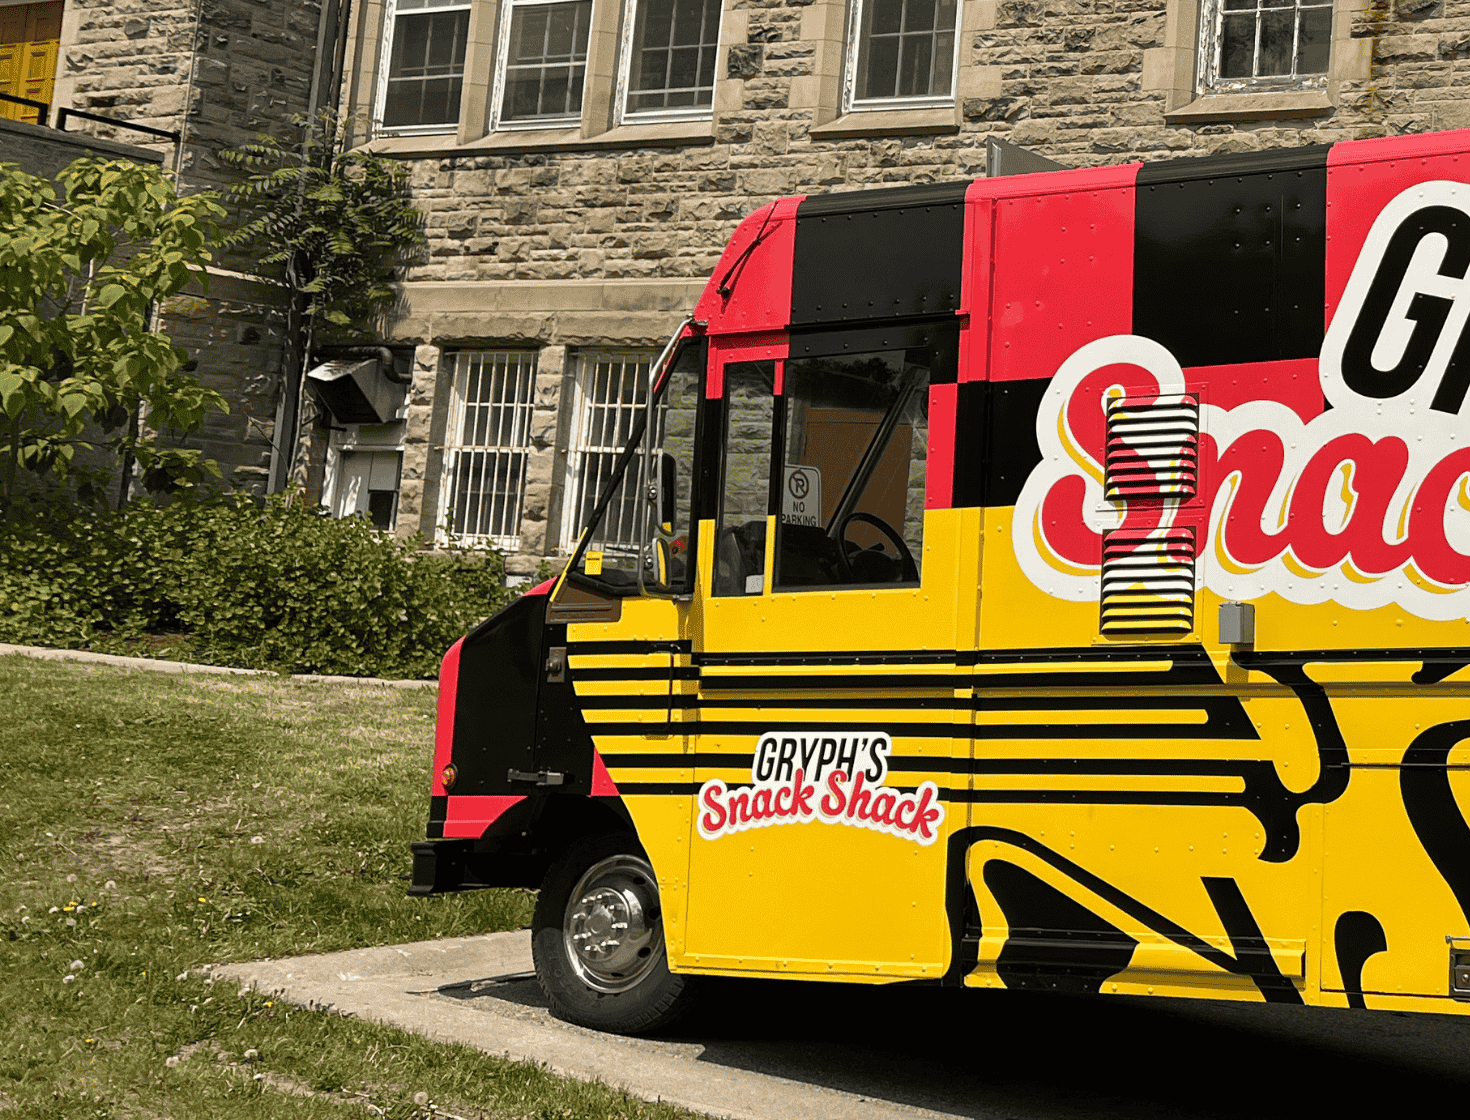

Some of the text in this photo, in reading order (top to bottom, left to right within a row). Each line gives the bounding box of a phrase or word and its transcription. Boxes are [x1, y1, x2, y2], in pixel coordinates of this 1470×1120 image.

[781, 514, 817, 526] PARKING
[793, 501, 805, 513] NO
[756, 738, 887, 782] GRYPH'S
[703, 768, 940, 839] Snack Shack
